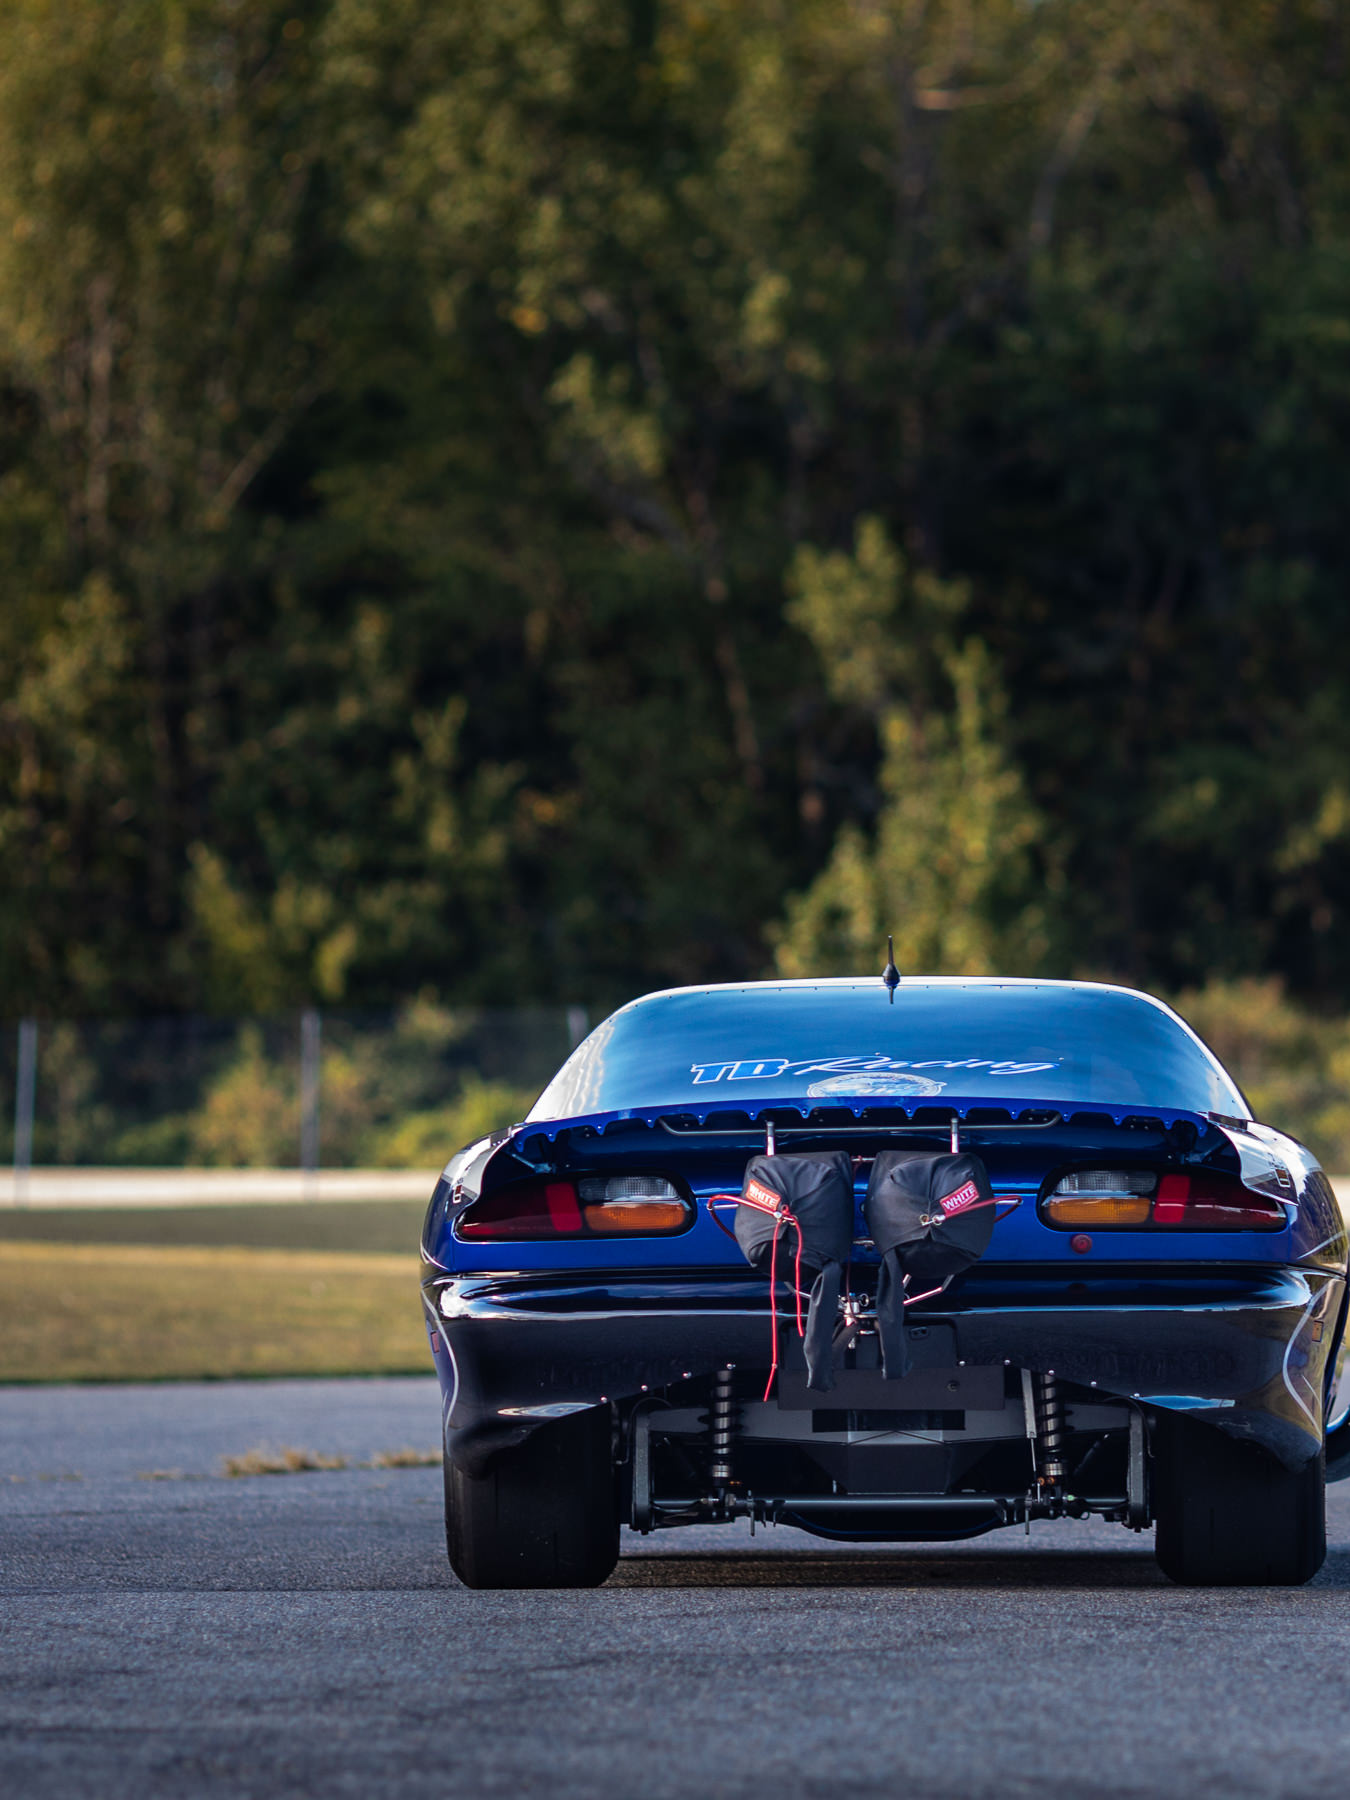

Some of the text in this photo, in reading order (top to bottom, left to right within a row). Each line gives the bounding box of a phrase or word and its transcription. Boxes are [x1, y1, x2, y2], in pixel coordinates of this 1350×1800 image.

[779, 1056, 1060, 1075] Racing
[749, 1183, 778, 1207] WHITE
[943, 1184, 975, 1210] WHITE
